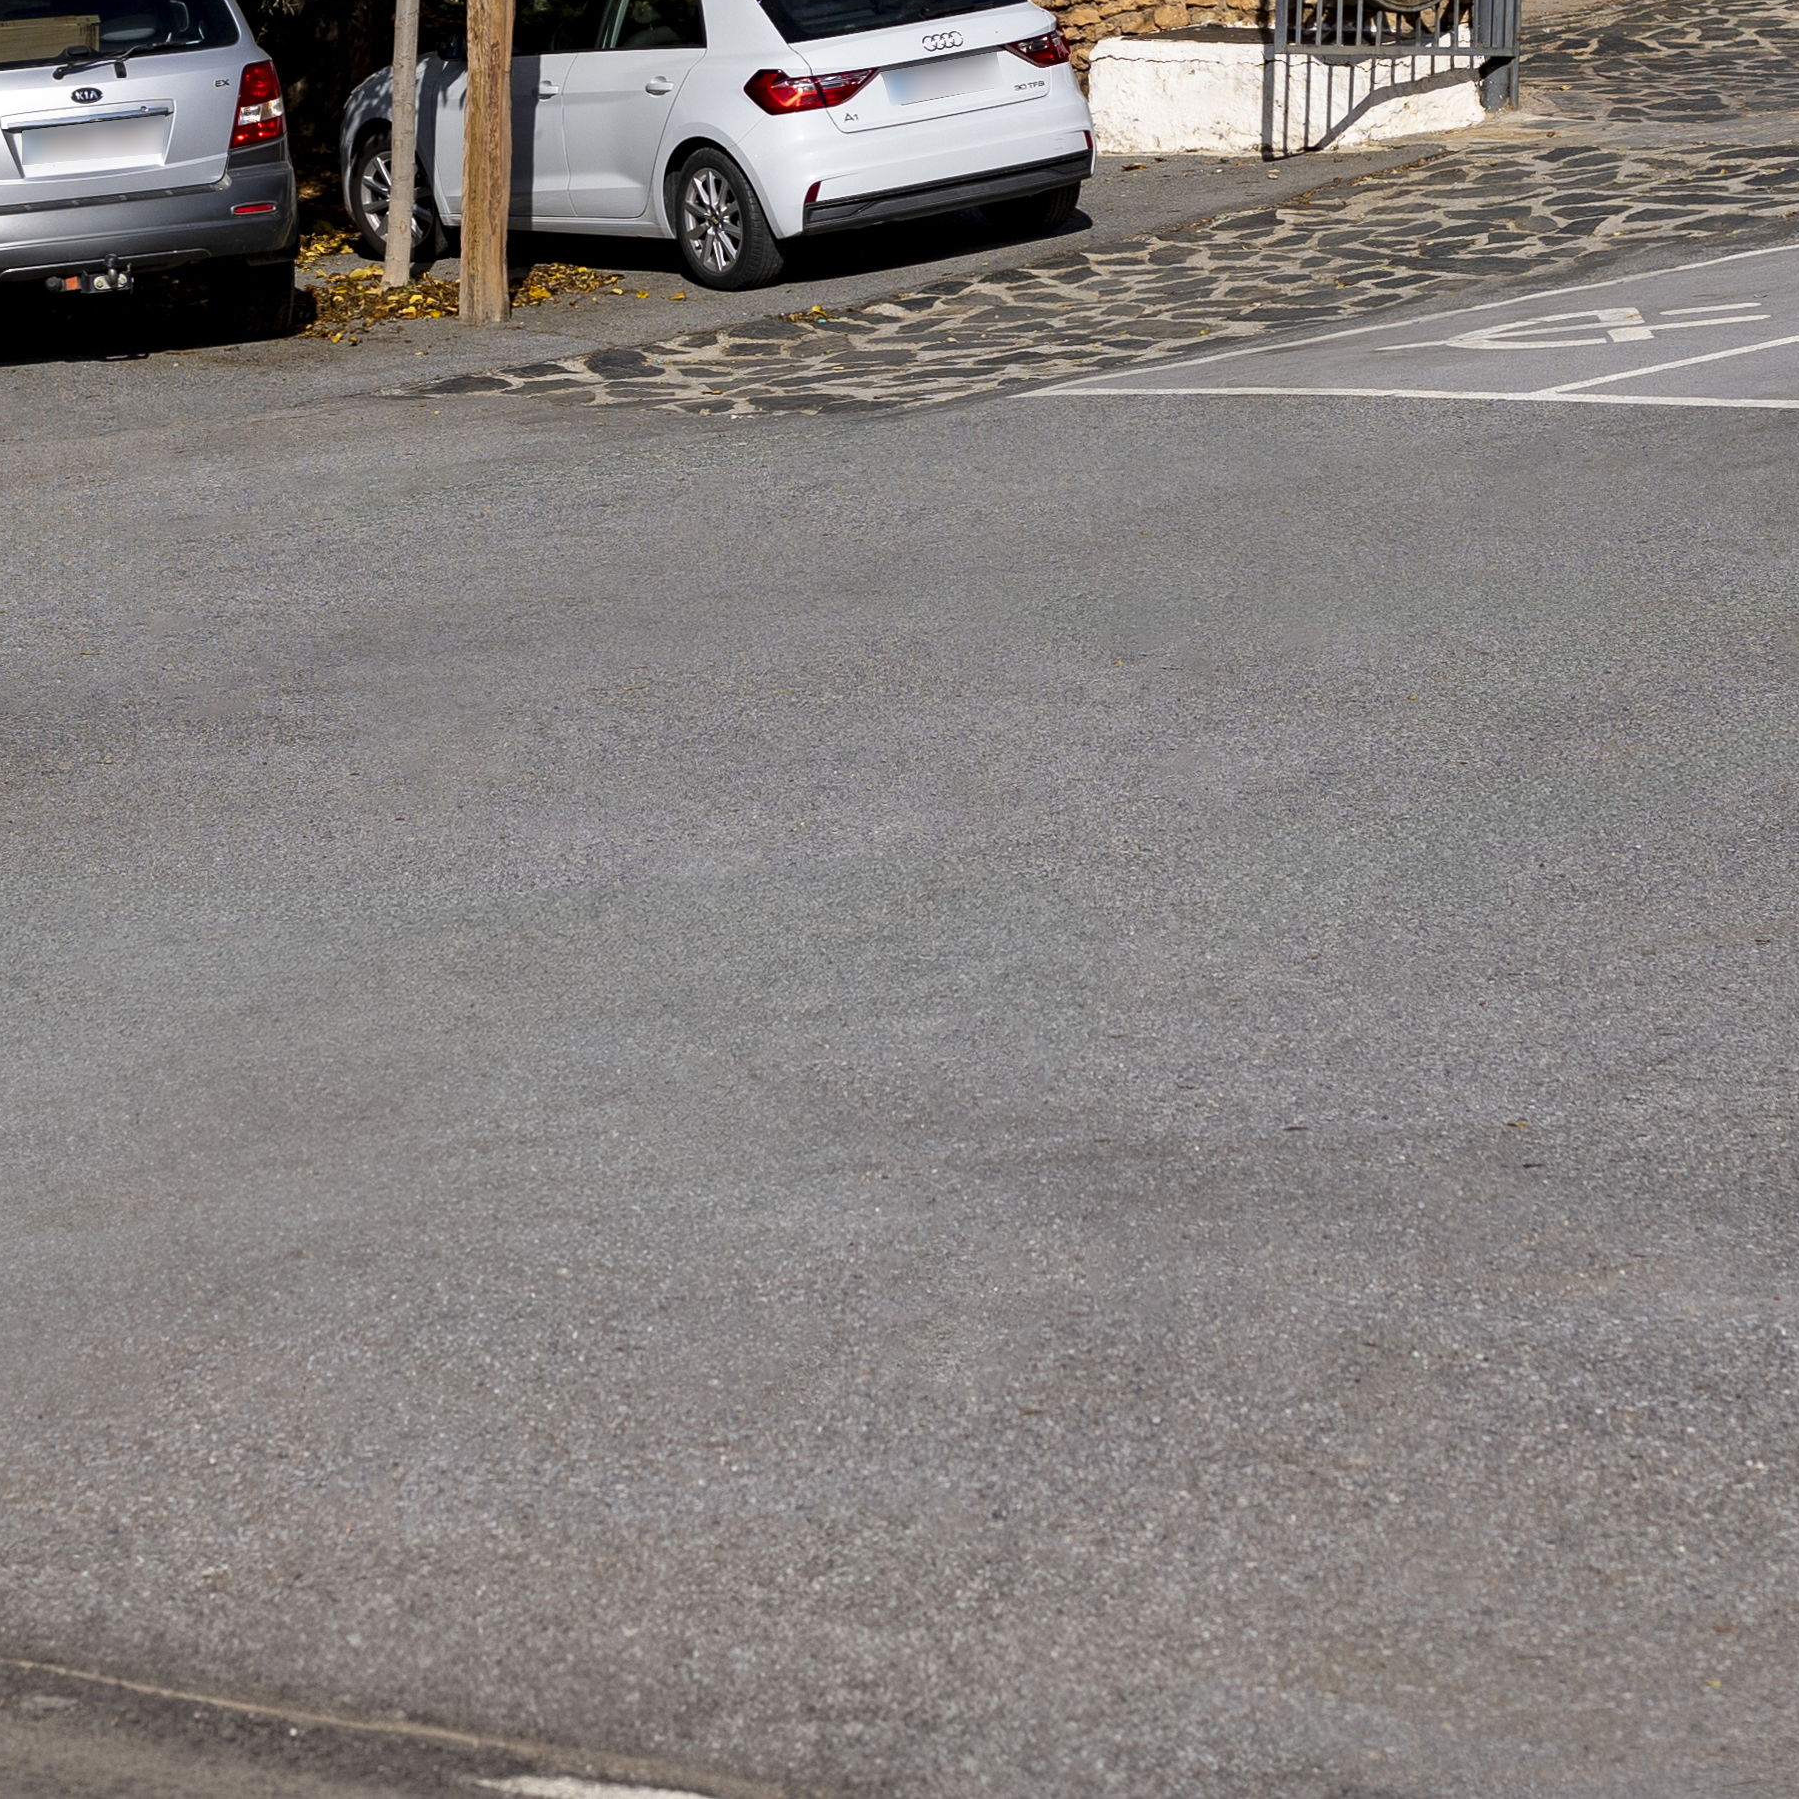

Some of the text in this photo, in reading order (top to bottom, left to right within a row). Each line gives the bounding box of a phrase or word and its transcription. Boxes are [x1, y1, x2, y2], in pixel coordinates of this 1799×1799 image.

[214, 78, 231, 88] EX
[74, 90, 99, 101] KIA
[843, 112, 859, 122] A1
